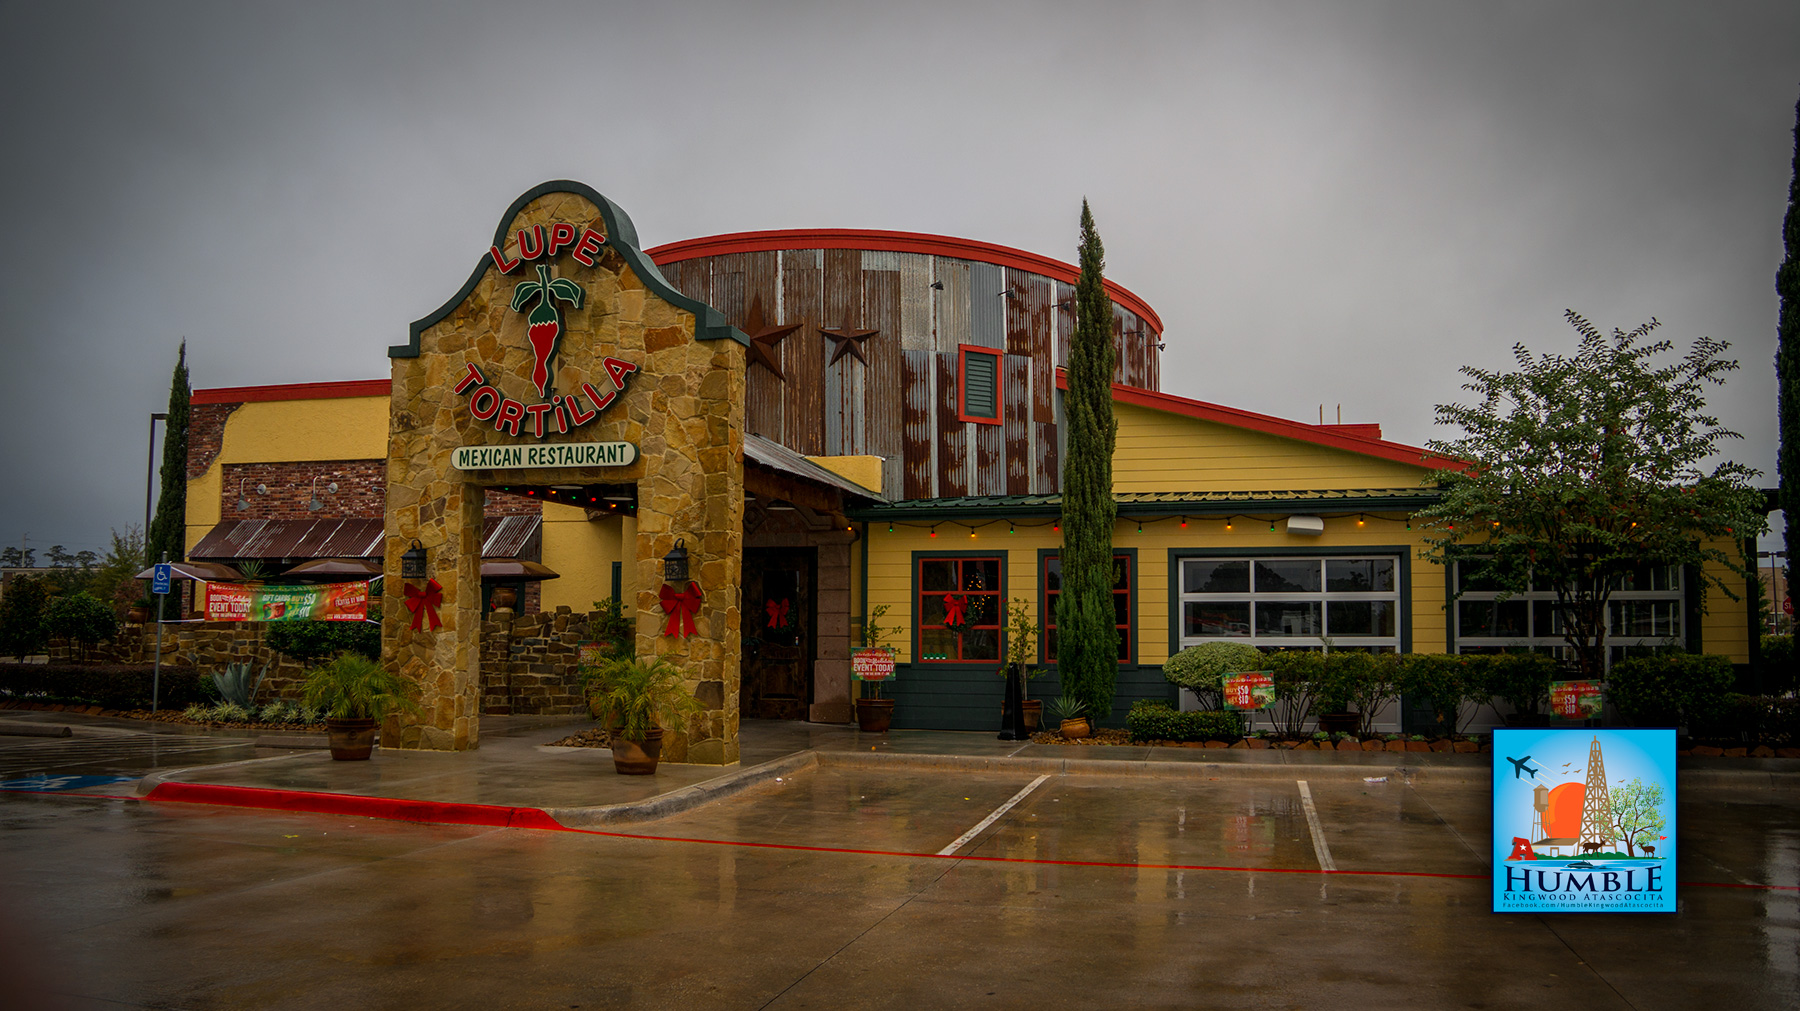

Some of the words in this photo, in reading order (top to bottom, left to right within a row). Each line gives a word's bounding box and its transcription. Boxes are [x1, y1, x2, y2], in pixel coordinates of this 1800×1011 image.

[490, 223, 606, 274] LUPE
[459, 447, 522, 467] MEXICAN
[528, 444, 627, 465] RESTAURANT
[209, 602, 229, 612] EVENT
[230, 602, 252, 612] TODAY
[853, 664, 873, 672] EVENT
[875, 664, 895, 672] TODAY
[1237, 685, 1249, 695] $50
[1238, 695, 1249, 705] $10
[1564, 695, 1576, 704] $50
[1565, 705, 1576, 714] $10
